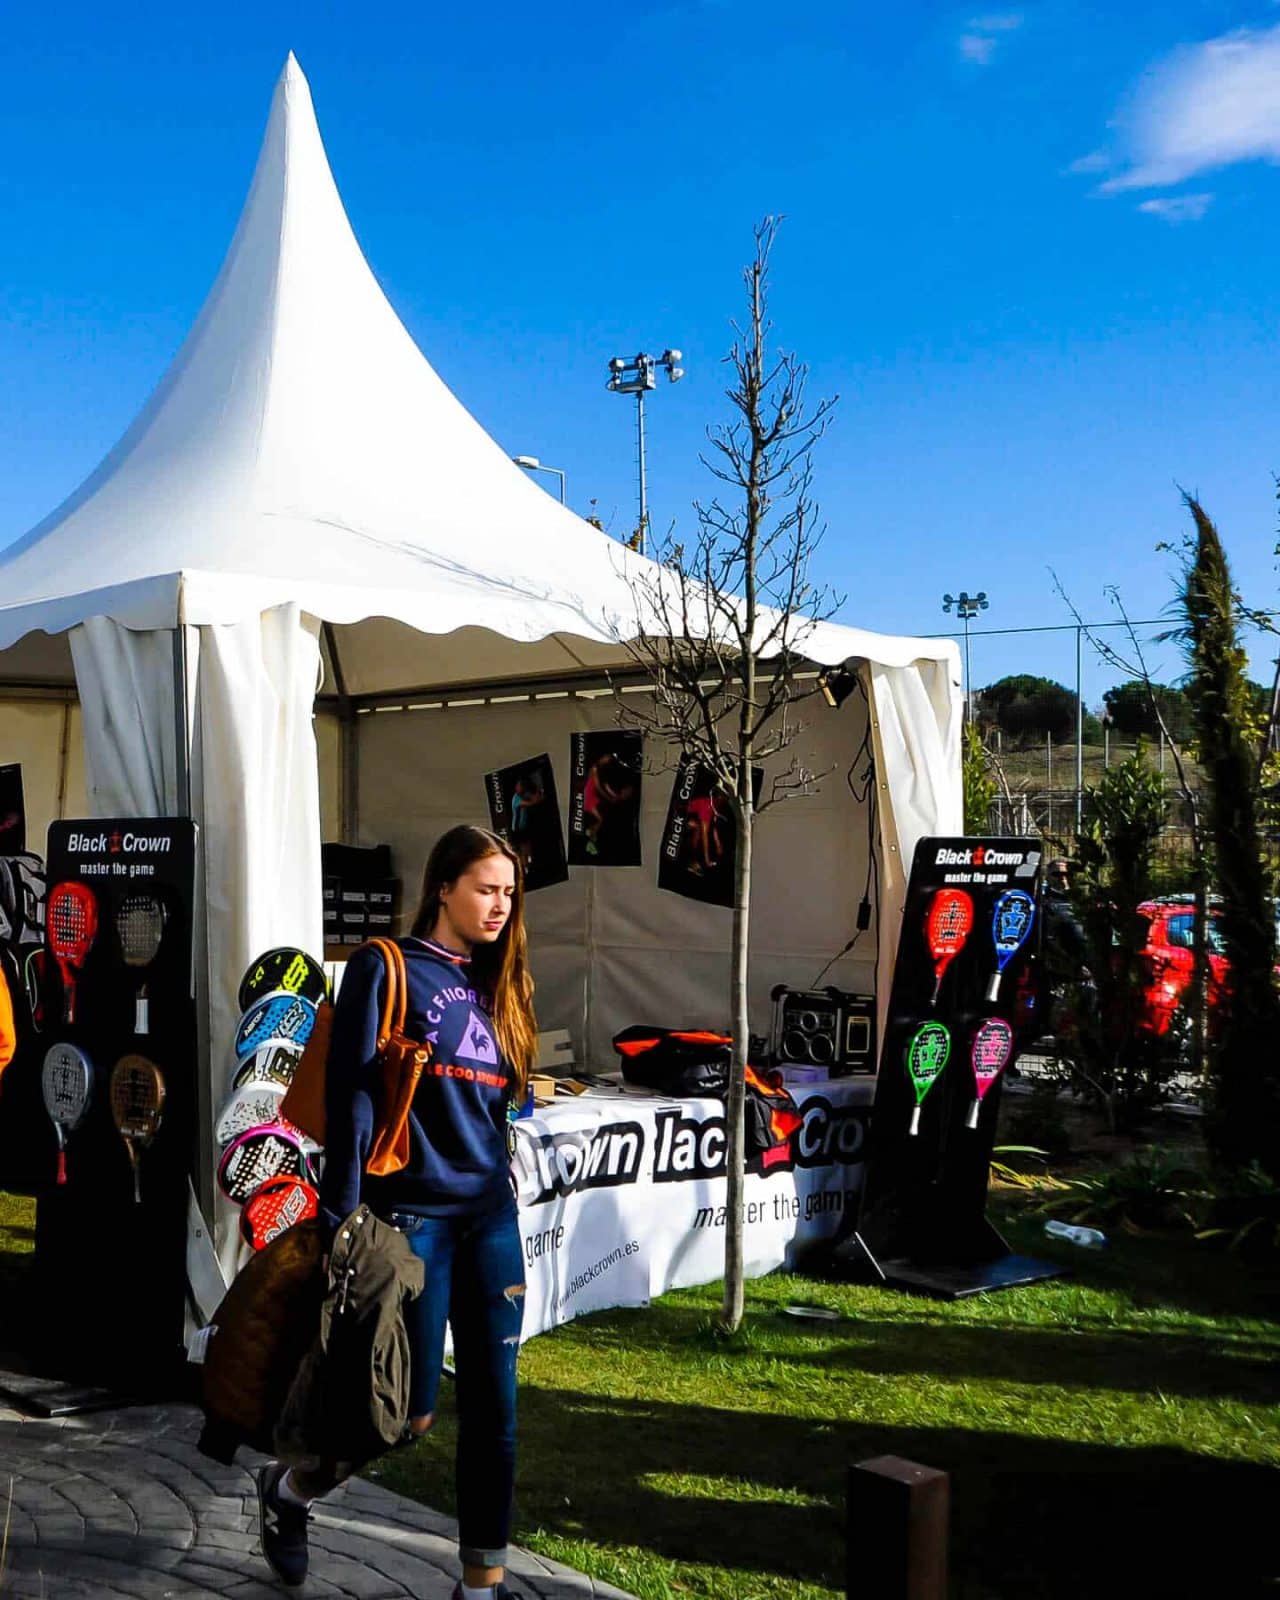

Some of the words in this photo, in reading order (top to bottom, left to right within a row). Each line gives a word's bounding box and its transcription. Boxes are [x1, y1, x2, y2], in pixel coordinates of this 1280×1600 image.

[574, 793, 584, 832] Black
[67, 833, 107, 852] Black
[122, 832, 171, 852] Crown
[667, 816, 684, 857] Black
[80, 862, 110, 875] master
[112, 862, 127, 875] the
[130, 864, 154, 878] game
[935, 848, 972, 865] Black
[984, 848, 1023, 865] Crown
[944, 872, 972, 883] master
[973, 871, 986, 883] the
[987, 873, 1008, 884] game
[656, 1116, 746, 1172] lac
[693, 1201, 766, 1229] maer
[773, 1193, 800, 1221] the
[525, 1225, 565, 1268] game
